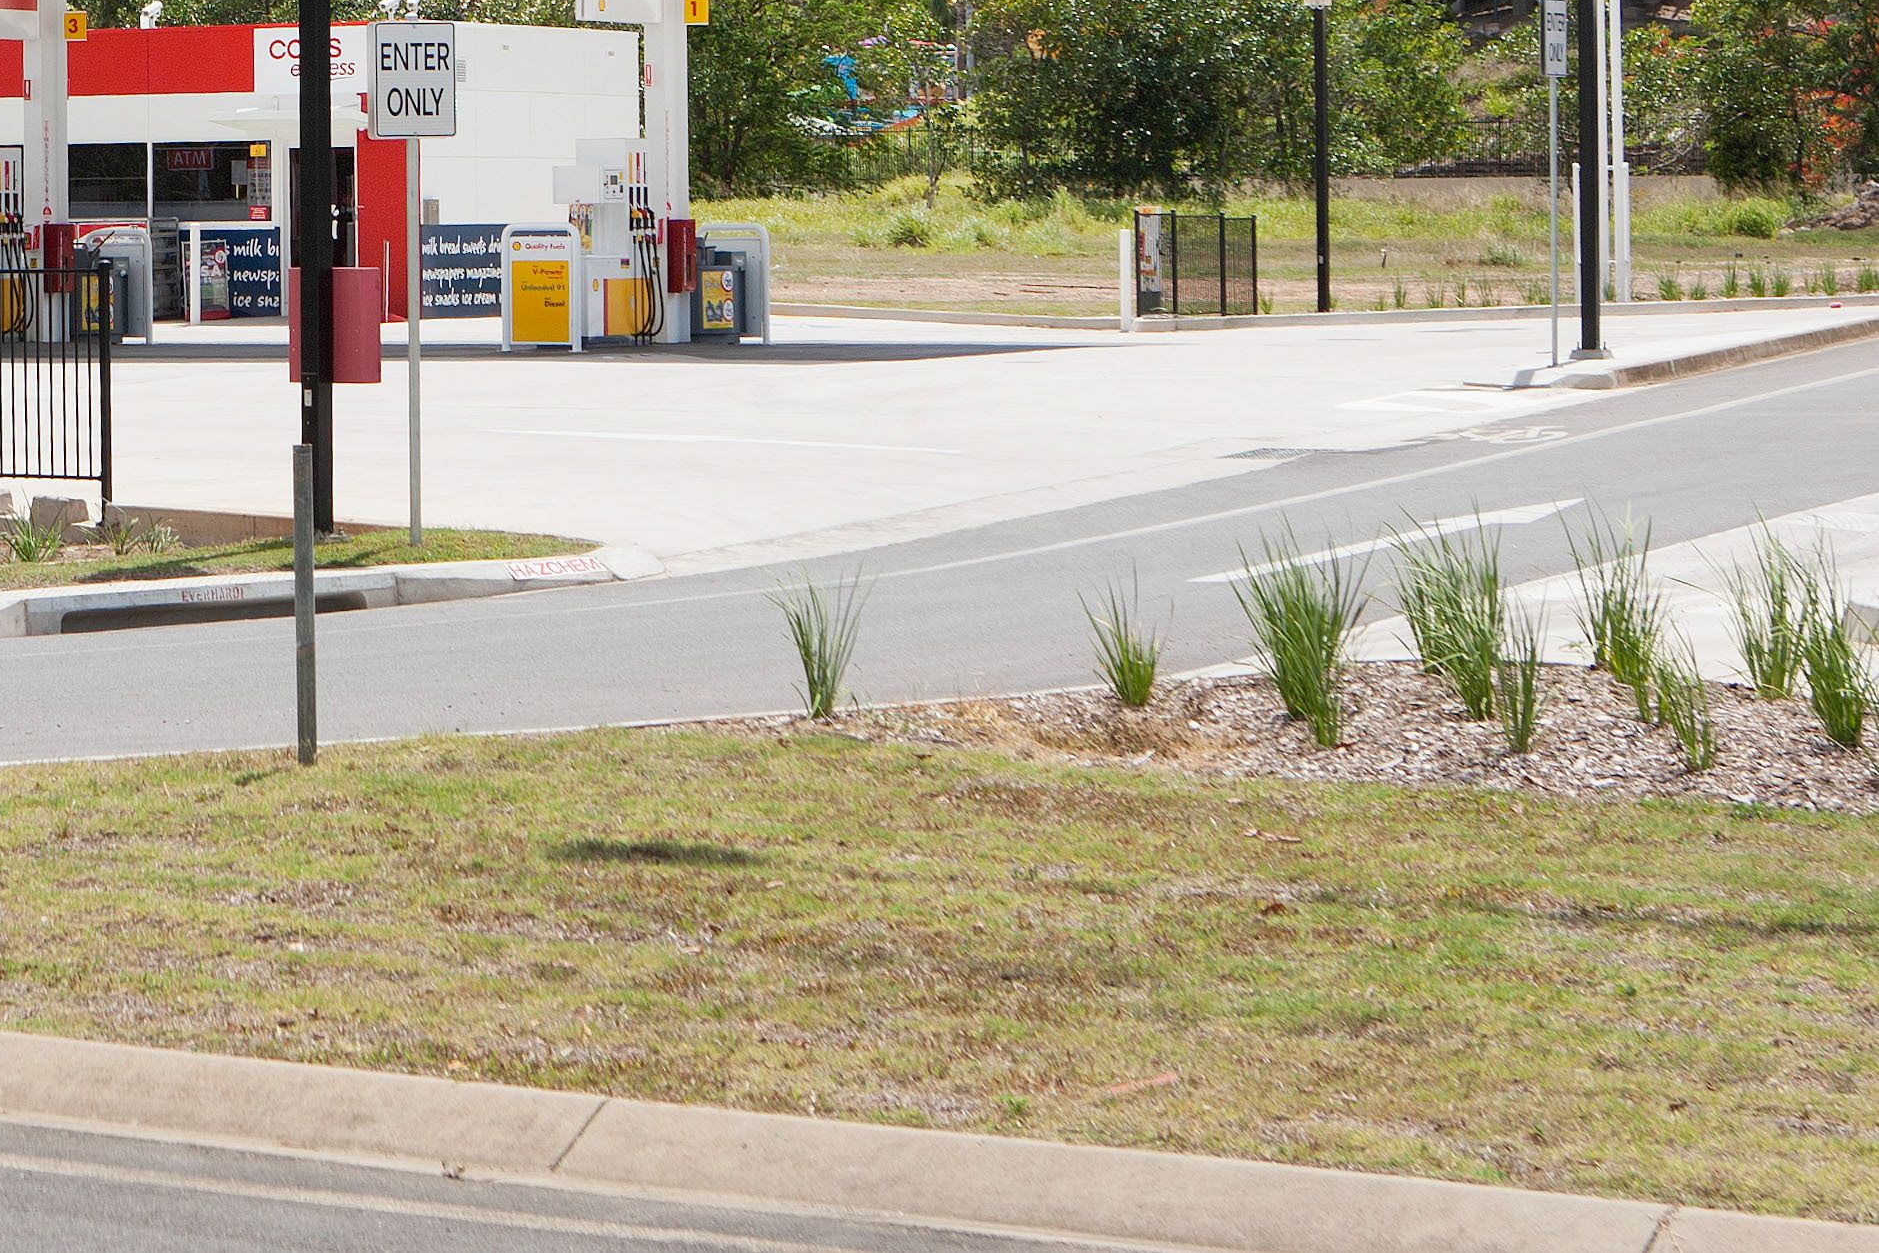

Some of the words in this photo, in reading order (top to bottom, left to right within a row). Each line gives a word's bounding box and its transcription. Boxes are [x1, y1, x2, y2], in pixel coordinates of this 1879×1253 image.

[690, 1, 697, 16] 1
[68, 18, 78, 33] 3
[381, 42, 450, 71] ENTER
[387, 87, 444, 116] ONLY
[173, 150, 207, 166] ATM
[233, 238, 262, 257] milk
[440, 235, 460, 254] bread
[462, 236, 486, 255] sweets
[422, 267, 465, 288] newspapers
[233, 291, 252, 307] ice
[435, 287, 460, 307] snacks
[462, 289, 472, 306] ice
[508, 557, 601, 579] HAZCHEM
